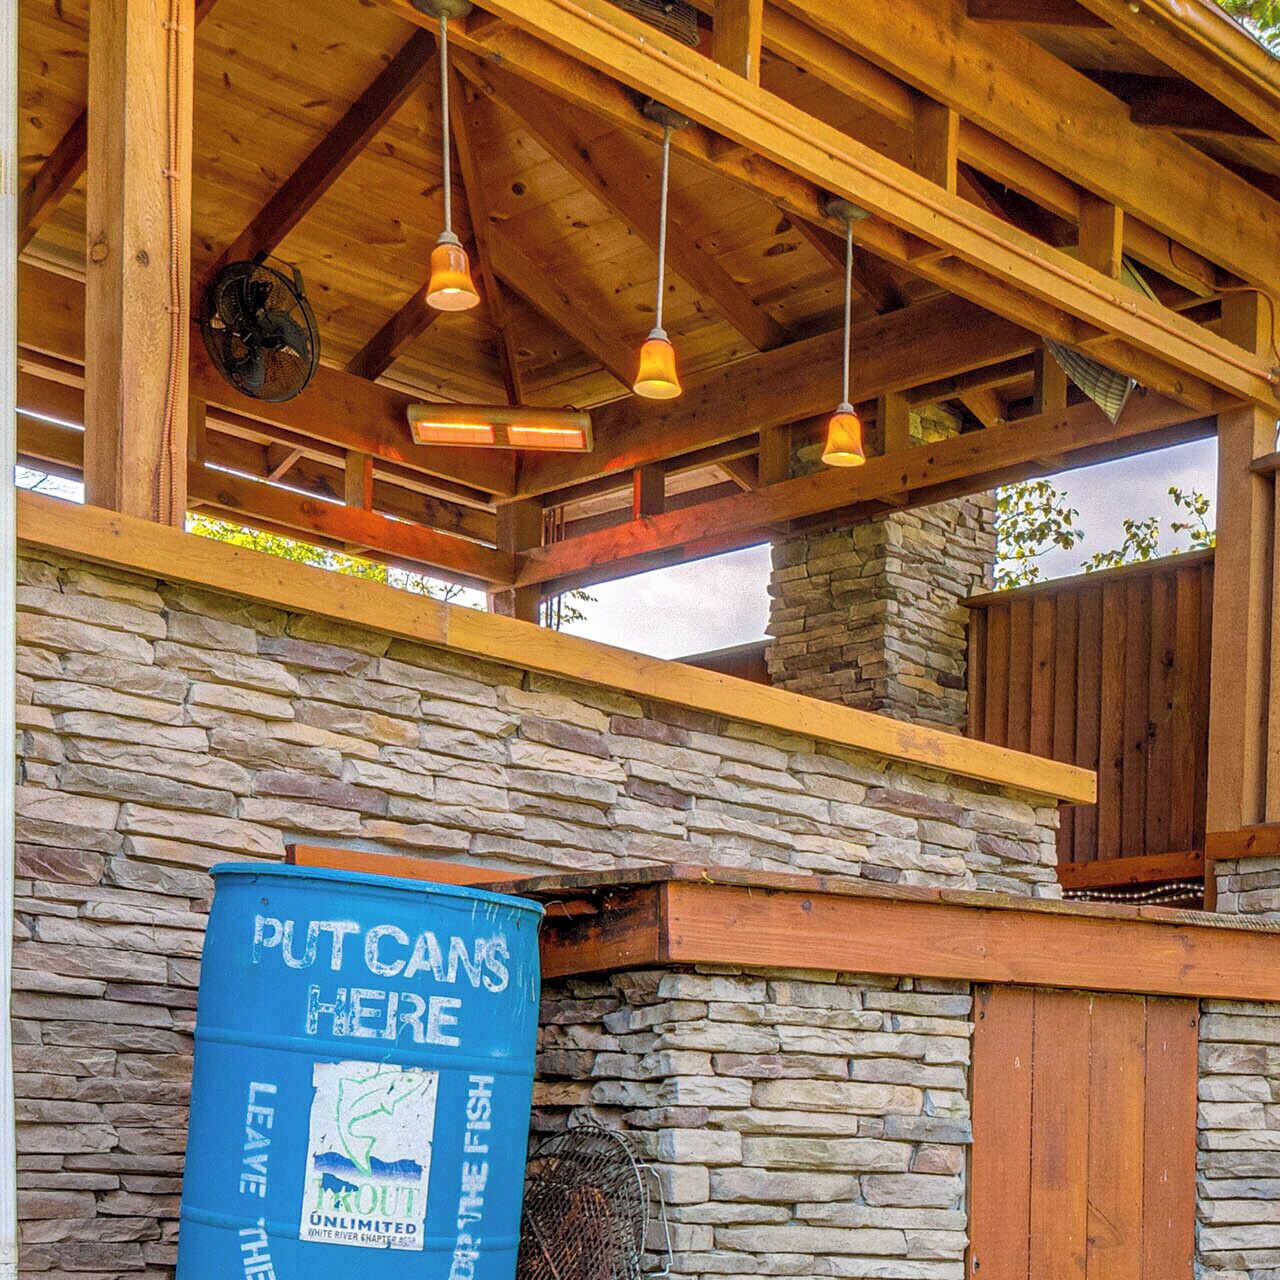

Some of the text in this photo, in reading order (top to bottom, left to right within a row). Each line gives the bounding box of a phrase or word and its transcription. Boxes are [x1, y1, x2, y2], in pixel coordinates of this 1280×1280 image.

[253, 913, 511, 993] PUT CANS
[305, 984, 462, 1047] HERE
[239, 1081, 278, 1198] LEAVE
[463, 1074, 494, 1153] FISH
[309, 1212, 417, 1234] UNLIMITED
[457, 1160, 489, 1230] THE
[307, 1227, 333, 1239] WHITE
[334, 1230, 359, 1241] RIVER
[360, 1232, 397, 1245] CHAPTER
